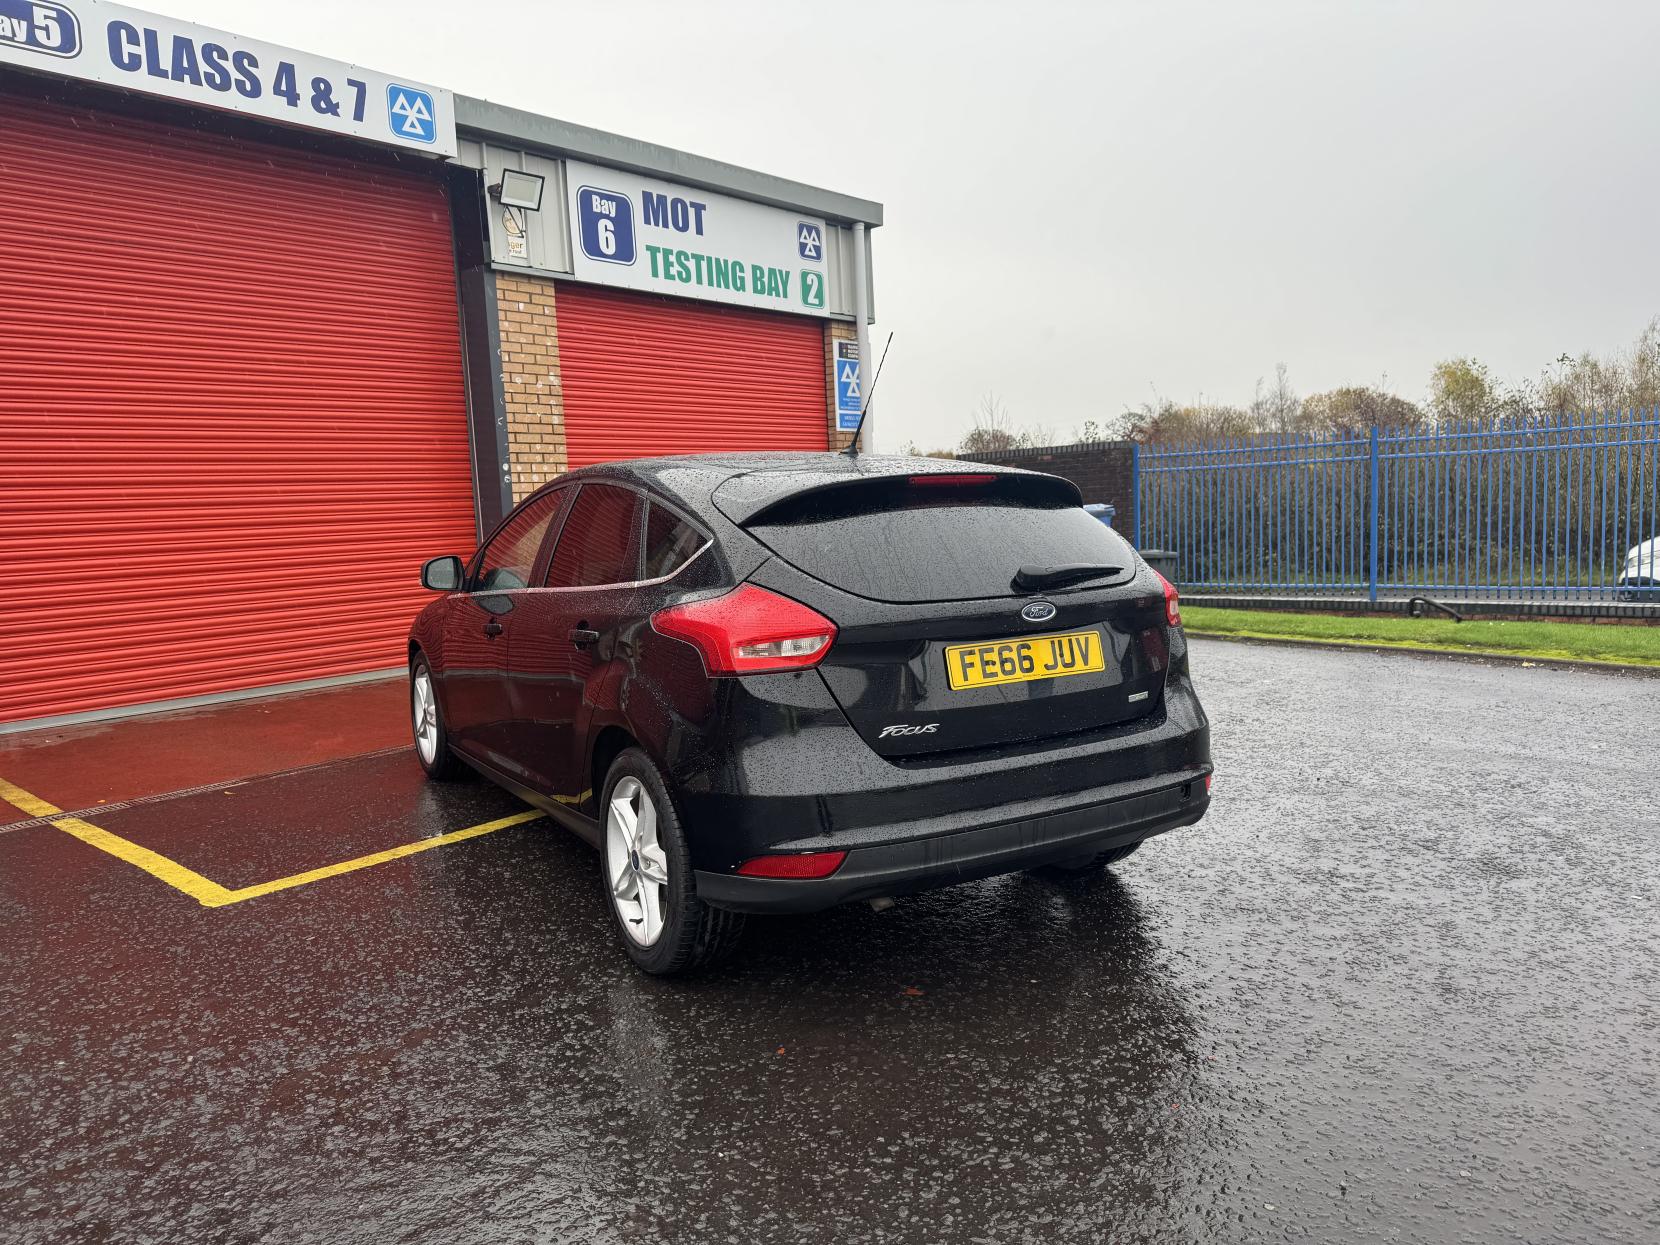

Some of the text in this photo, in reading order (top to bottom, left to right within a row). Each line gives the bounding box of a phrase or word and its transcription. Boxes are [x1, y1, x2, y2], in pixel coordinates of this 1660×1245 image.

[0, 6, 61, 47] ay 5
[107, 20, 366, 122] CLASS 4 & 7
[592, 195, 616, 217] Bay
[642, 190, 706, 236] MOT
[598, 219, 616, 255] 6
[645, 244, 790, 298] TESTING BAY
[806, 274, 819, 304] 2
[959, 637, 1089, 681] FE66 JUV
